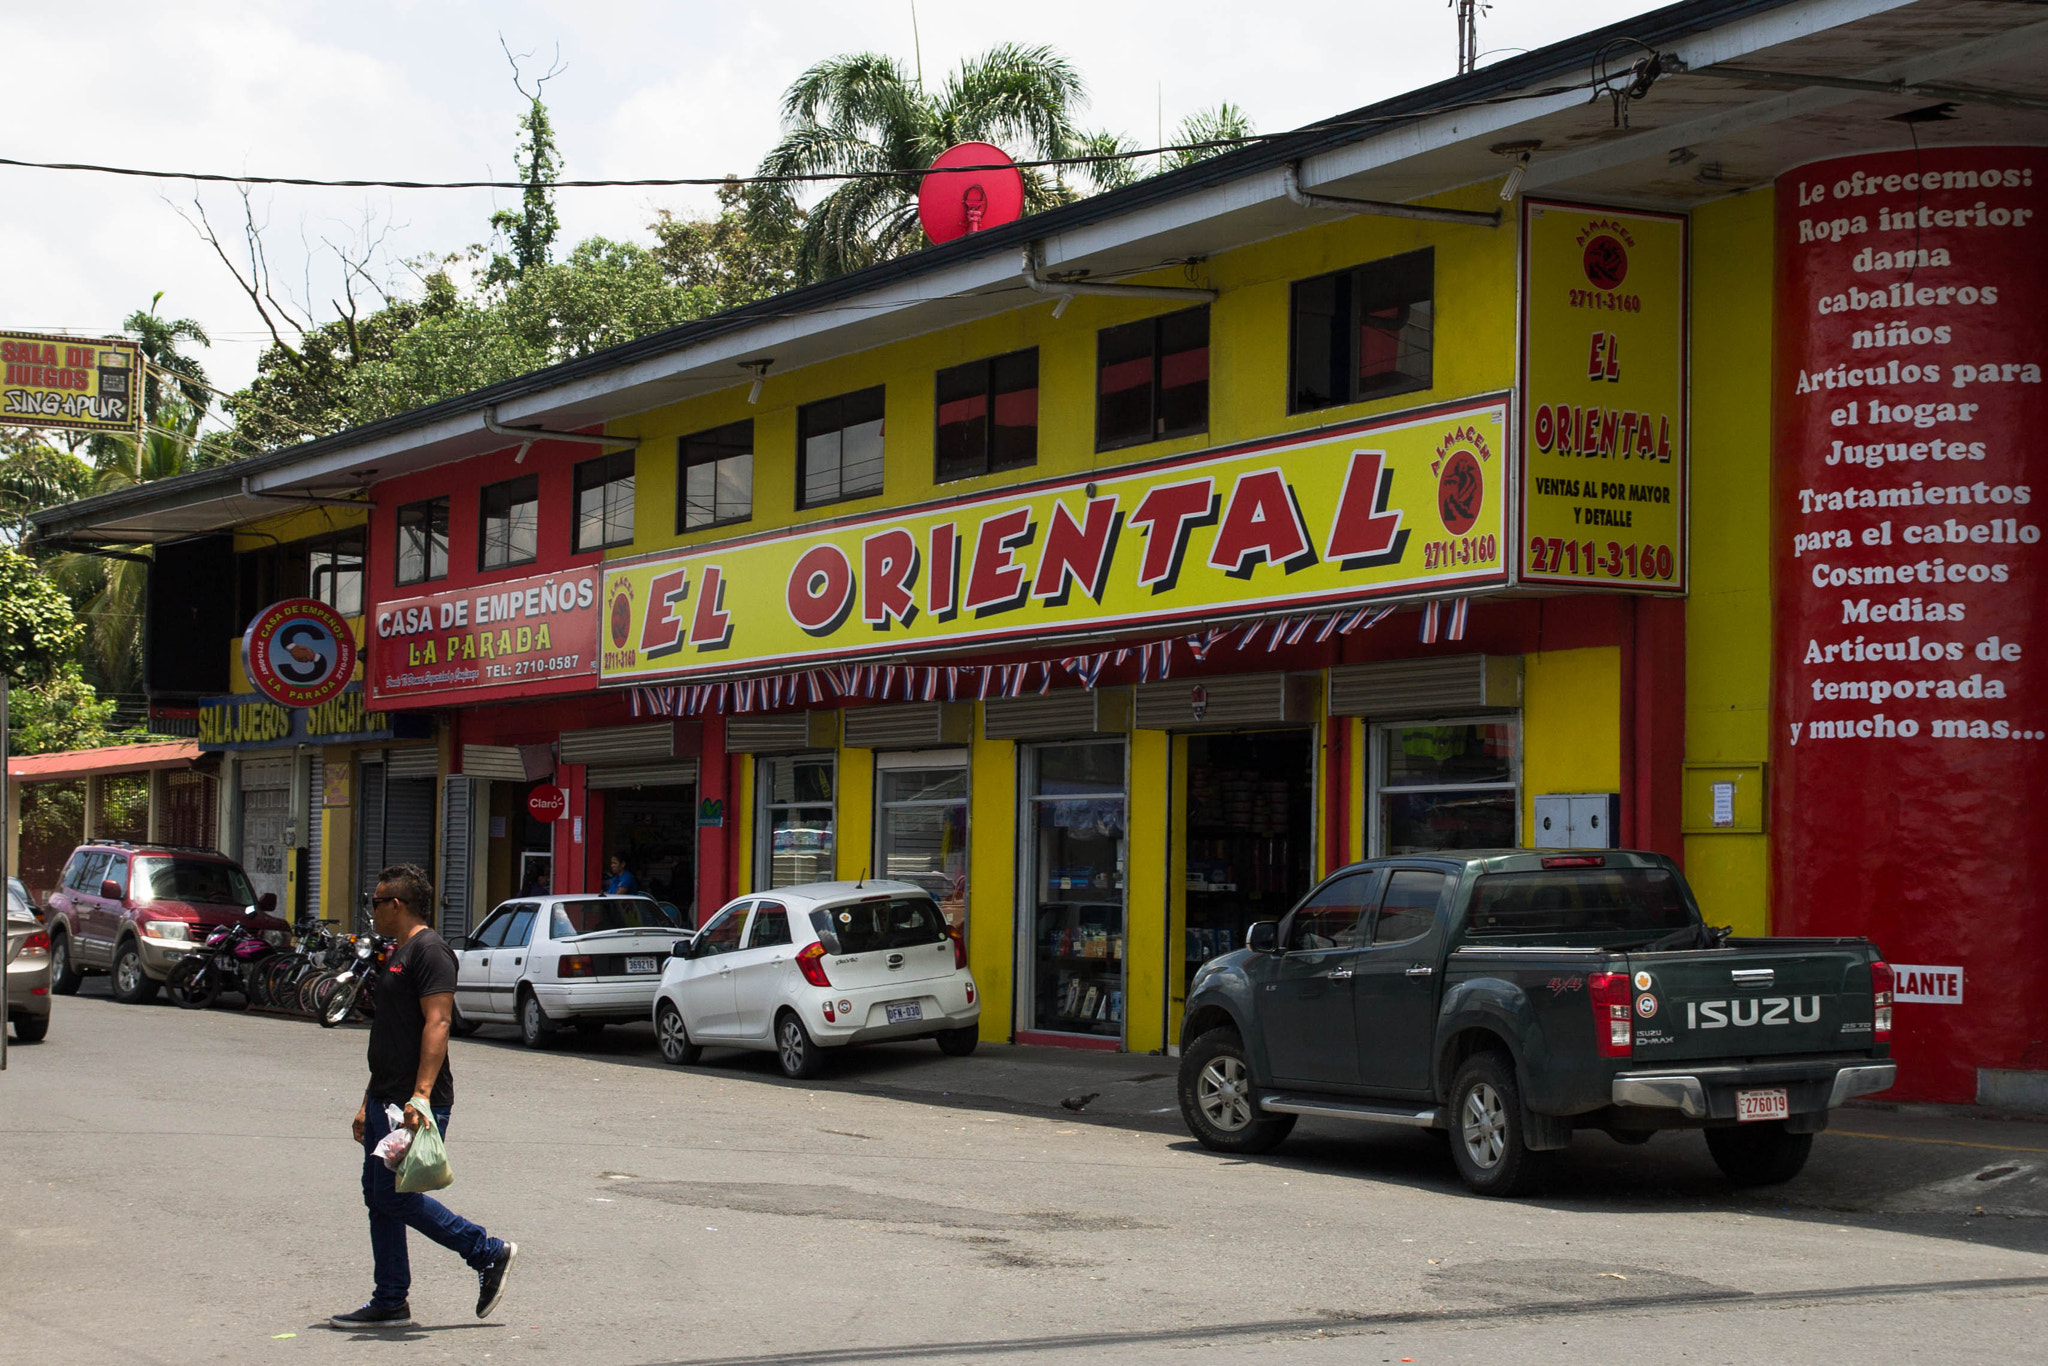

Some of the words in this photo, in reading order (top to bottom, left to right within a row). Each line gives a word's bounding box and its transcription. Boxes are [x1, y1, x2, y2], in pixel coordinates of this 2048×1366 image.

[1799, 182, 1825, 207] Le
[1833, 169, 2032, 199] ofrecemos:
[1576, 219, 1635, 248] ALMACEN
[1799, 216, 1868, 244] Ropa
[1879, 201, 2033, 231] interior
[1852, 247, 1951, 272] dama
[1569, 289, 1641, 313] 2711-3160
[1818, 282, 1998, 314] caballeros
[1852, 321, 1952, 349] niños
[1, 340, 58, 367] SALA
[66, 346, 95, 369] DE
[1587, 330, 1620, 383] EL
[4, 364, 89, 391] JUEGOS
[1795, 360, 1940, 395] Artículos
[1952, 363, 2042, 388] para
[4, 389, 123, 419] SINGAPUR
[1831, 401, 1859, 426] el
[1868, 400, 1979, 428] hogar
[1535, 403, 1670, 463] ORIENTAL
[1430, 425, 1491, 478] ALMACEN
[1825, 438, 1986, 469] Juguetes
[1536, 477, 1580, 497] VENTAS
[1583, 481, 1598, 498] AL
[1601, 482, 1625, 500] POR
[1628, 484, 1670, 504] MAYOR
[1799, 481, 2031, 514] Tratamientos
[1573, 507, 1581, 524] Y
[1585, 508, 1632, 527] DETALLE
[1424, 533, 1497, 569] 2711-3160
[1794, 528, 1853, 558] para
[1861, 521, 1892, 546] el
[1903, 518, 2041, 544] cabello
[639, 565, 735, 660] EL
[785, 450, 1411, 637] ORIENTAL
[1530, 536, 1673, 580] 2711-3160
[1812, 558, 2009, 588] Cosmeticos
[261, 613, 283, 638] CASA
[284, 605, 299, 616] DE
[378, 606, 433, 638] CASA
[440, 600, 469, 629] DE
[475, 578, 594, 625] EMPEÑOS
[1842, 597, 1966, 624] Medias
[408, 639, 438, 667] LA
[447, 623, 552, 662] PARADA
[604, 650, 636, 670] 2711-3160
[1803, 636, 1964, 664] Artículos
[1975, 636, 2022, 661] de
[486, 665, 511, 678] TEL:
[515, 655, 579, 675] 2710-0587
[267, 678, 281, 692] LA
[289, 680, 336, 700] PARADA
[1811, 674, 2007, 704] temporada
[198, 705, 232, 744] SALA
[233, 702, 291, 743] JUEGOS
[1790, 722, 1803, 746] y
[1809, 714, 1919, 739] mucho
[1931, 719, 2046, 740] mas...
[530, 798, 558, 809] Claro
[262, 845, 275, 856] NO
[1687, 996, 1821, 1029] ISUZU
[1636, 1036, 1674, 1046] D-MAX
[1746, 1096, 1785, 1113] 276019
